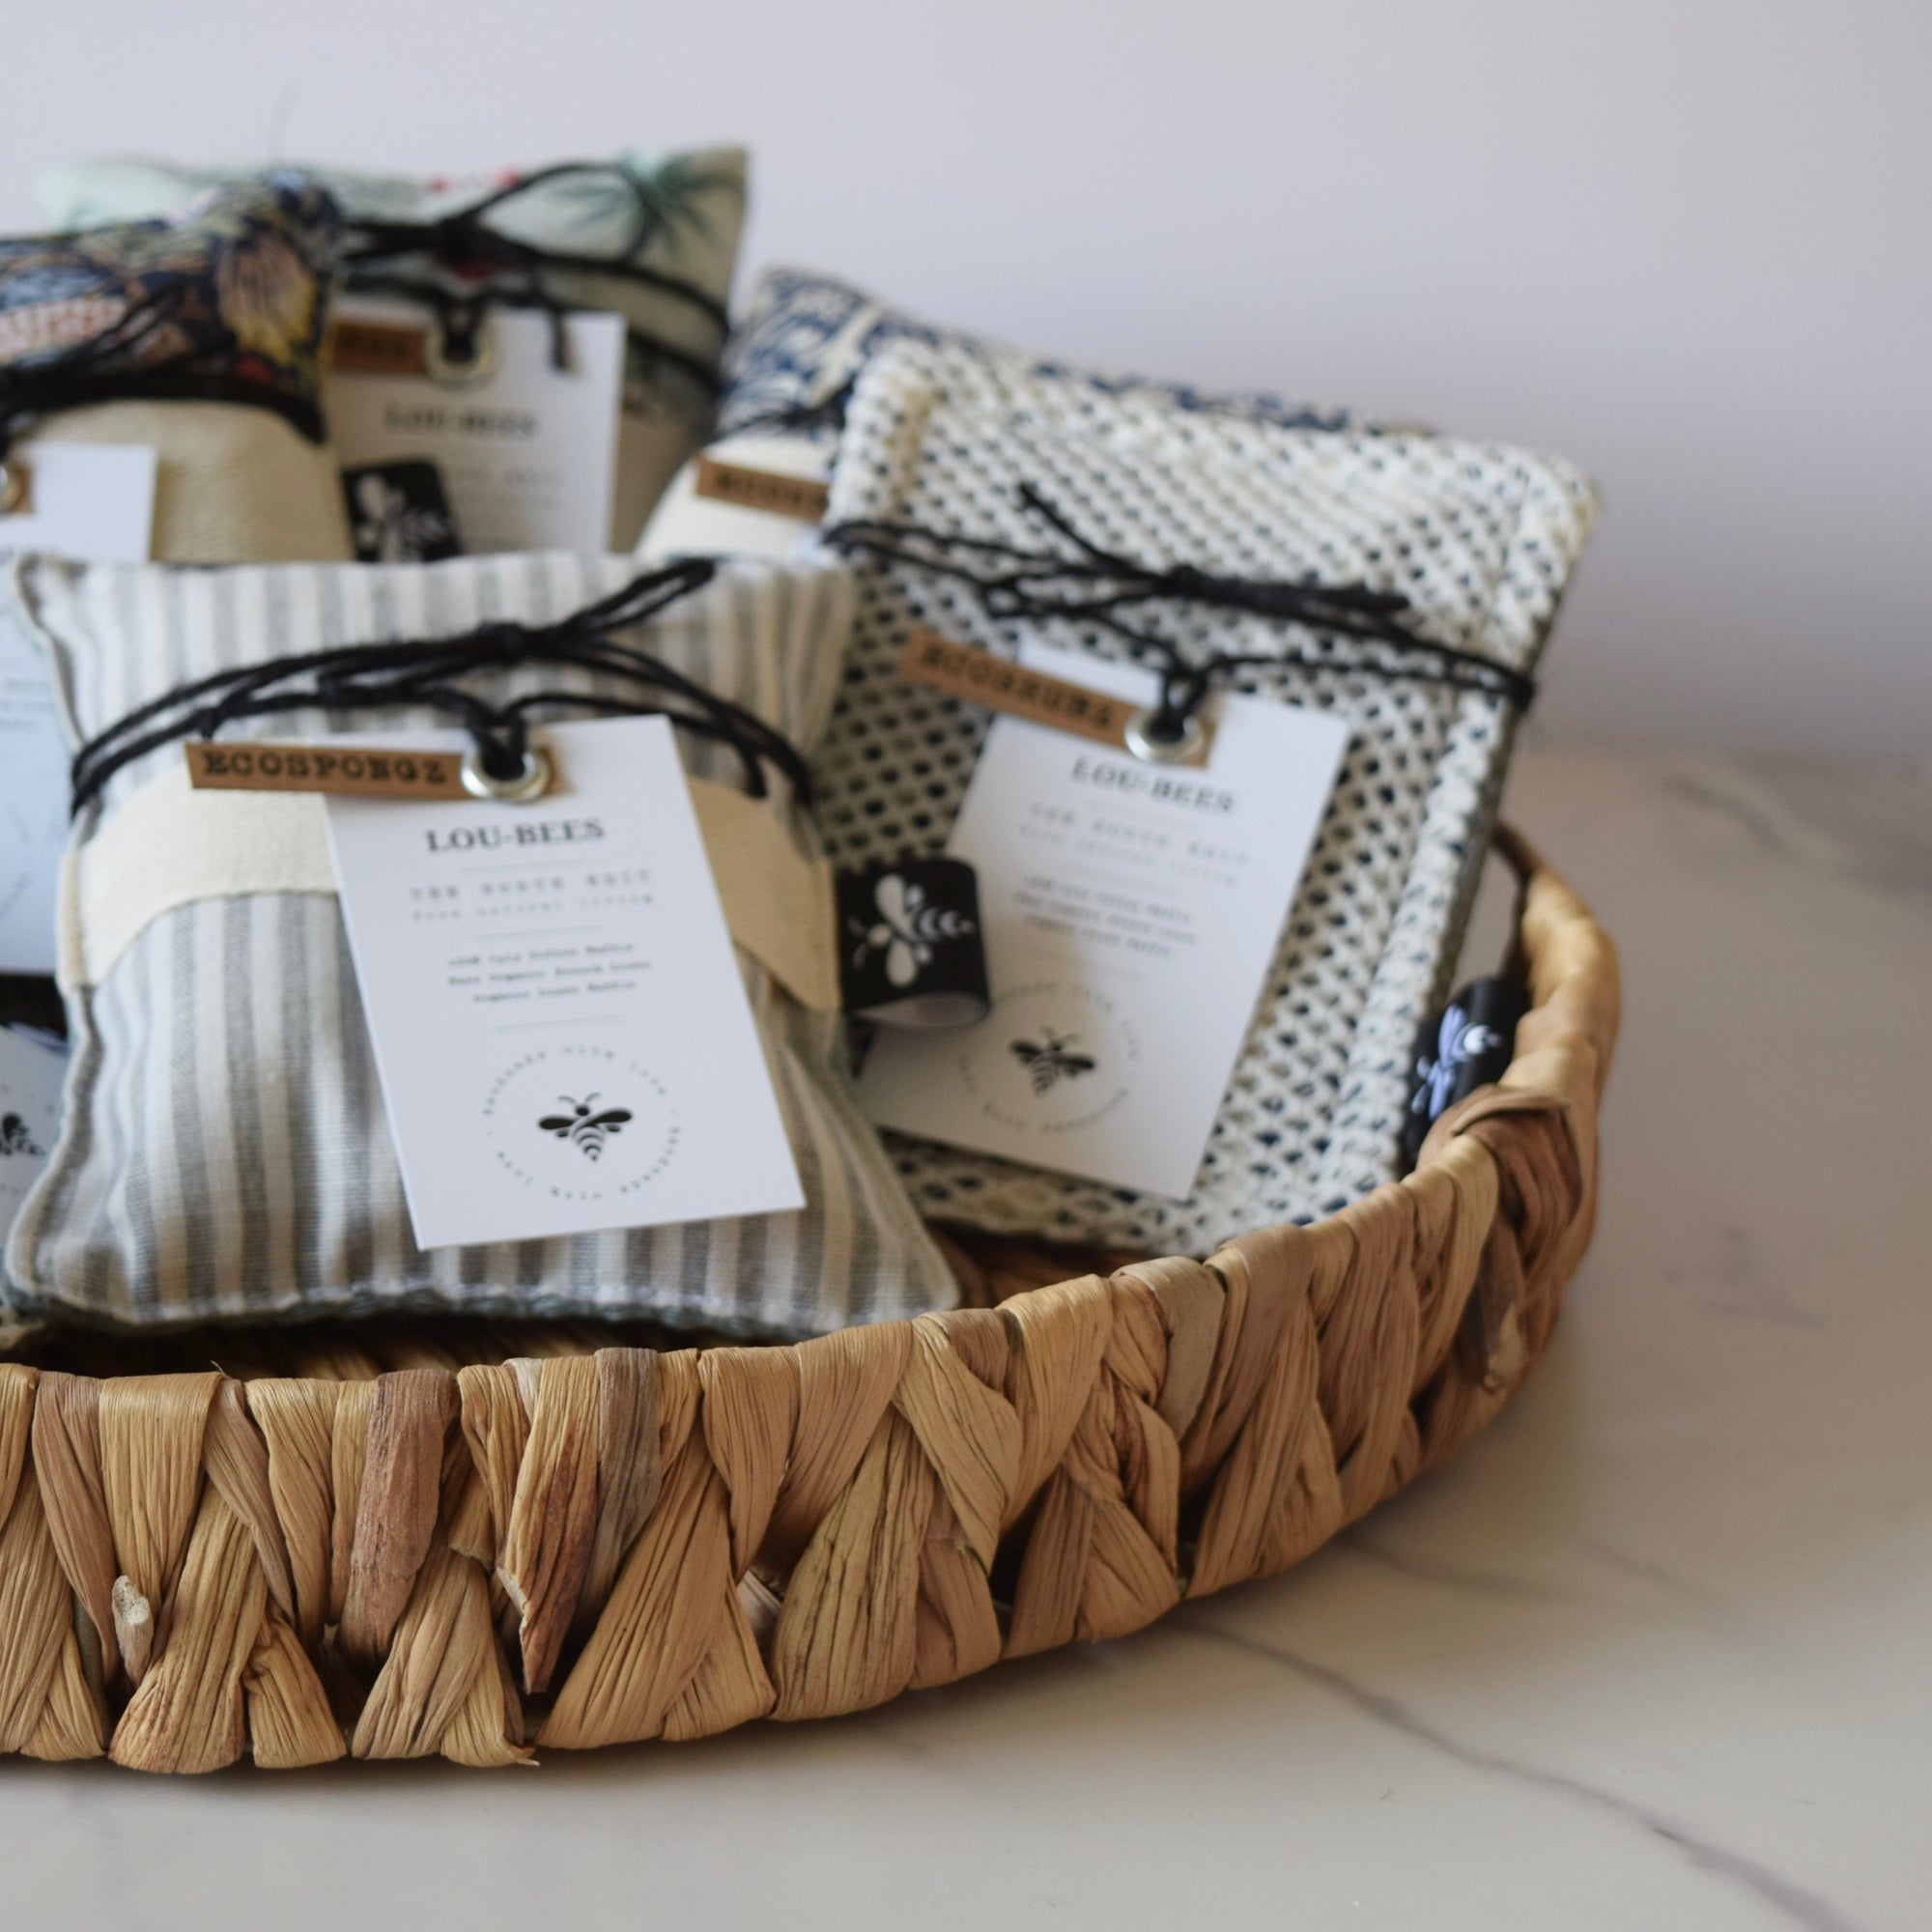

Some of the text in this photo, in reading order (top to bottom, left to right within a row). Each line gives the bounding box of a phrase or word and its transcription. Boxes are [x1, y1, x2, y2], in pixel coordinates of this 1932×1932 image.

[201, 751, 447, 784] ECOSPONGZ
[1071, 756, 1235, 811] LOU-BEES
[425, 818, 606, 854] LOU-BEES
